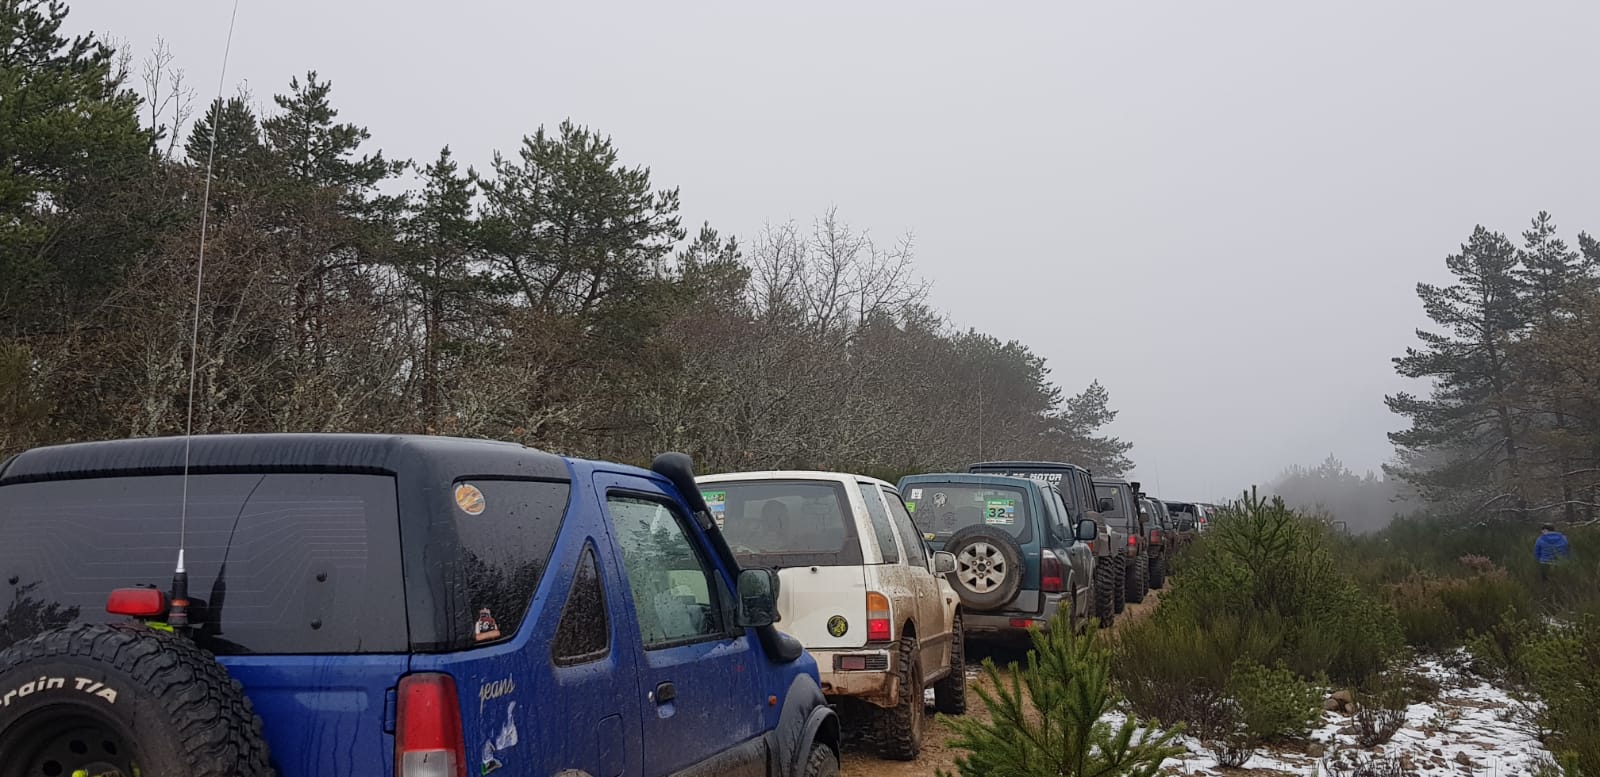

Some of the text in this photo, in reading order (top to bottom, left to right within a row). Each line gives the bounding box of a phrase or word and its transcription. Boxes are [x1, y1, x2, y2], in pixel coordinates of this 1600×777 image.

[1030, 473, 1062, 481] MOTOR
[988, 507, 1006, 518] 32
[0, 676, 118, 707] rain T/A
[479, 672, 516, 714] jeans
